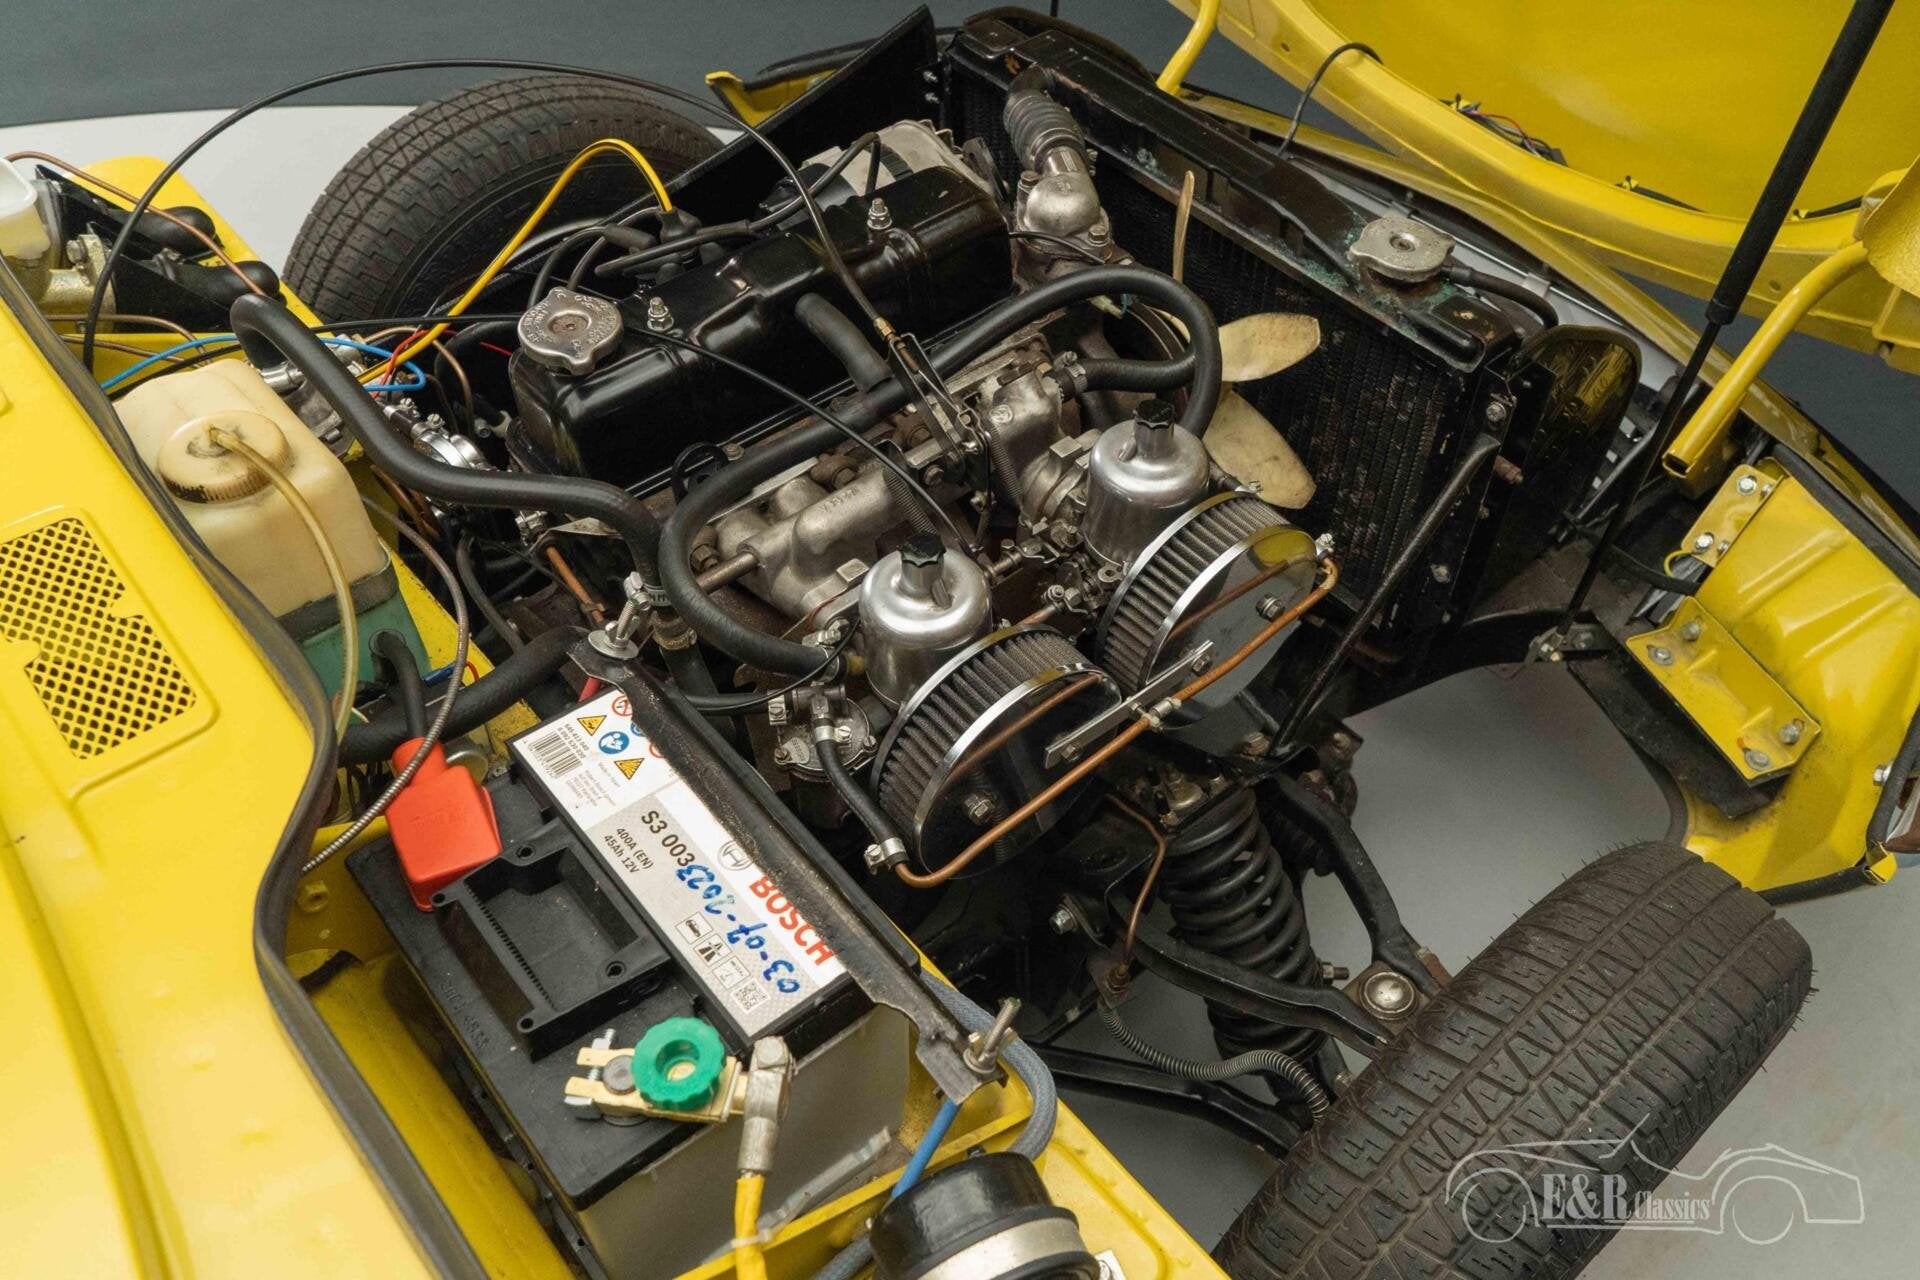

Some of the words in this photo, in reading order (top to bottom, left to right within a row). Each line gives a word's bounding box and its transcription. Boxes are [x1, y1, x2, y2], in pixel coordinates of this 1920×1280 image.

[604, 835, 626, 861] 45Ah
[621, 857, 640, 873] 12V
[615, 827, 637, 851] 400A
[633, 847, 654, 869] (EN)
[641, 810, 667, 835] S3
[662, 833, 696, 867] 003
[749, 876, 835, 967] BOSCH
